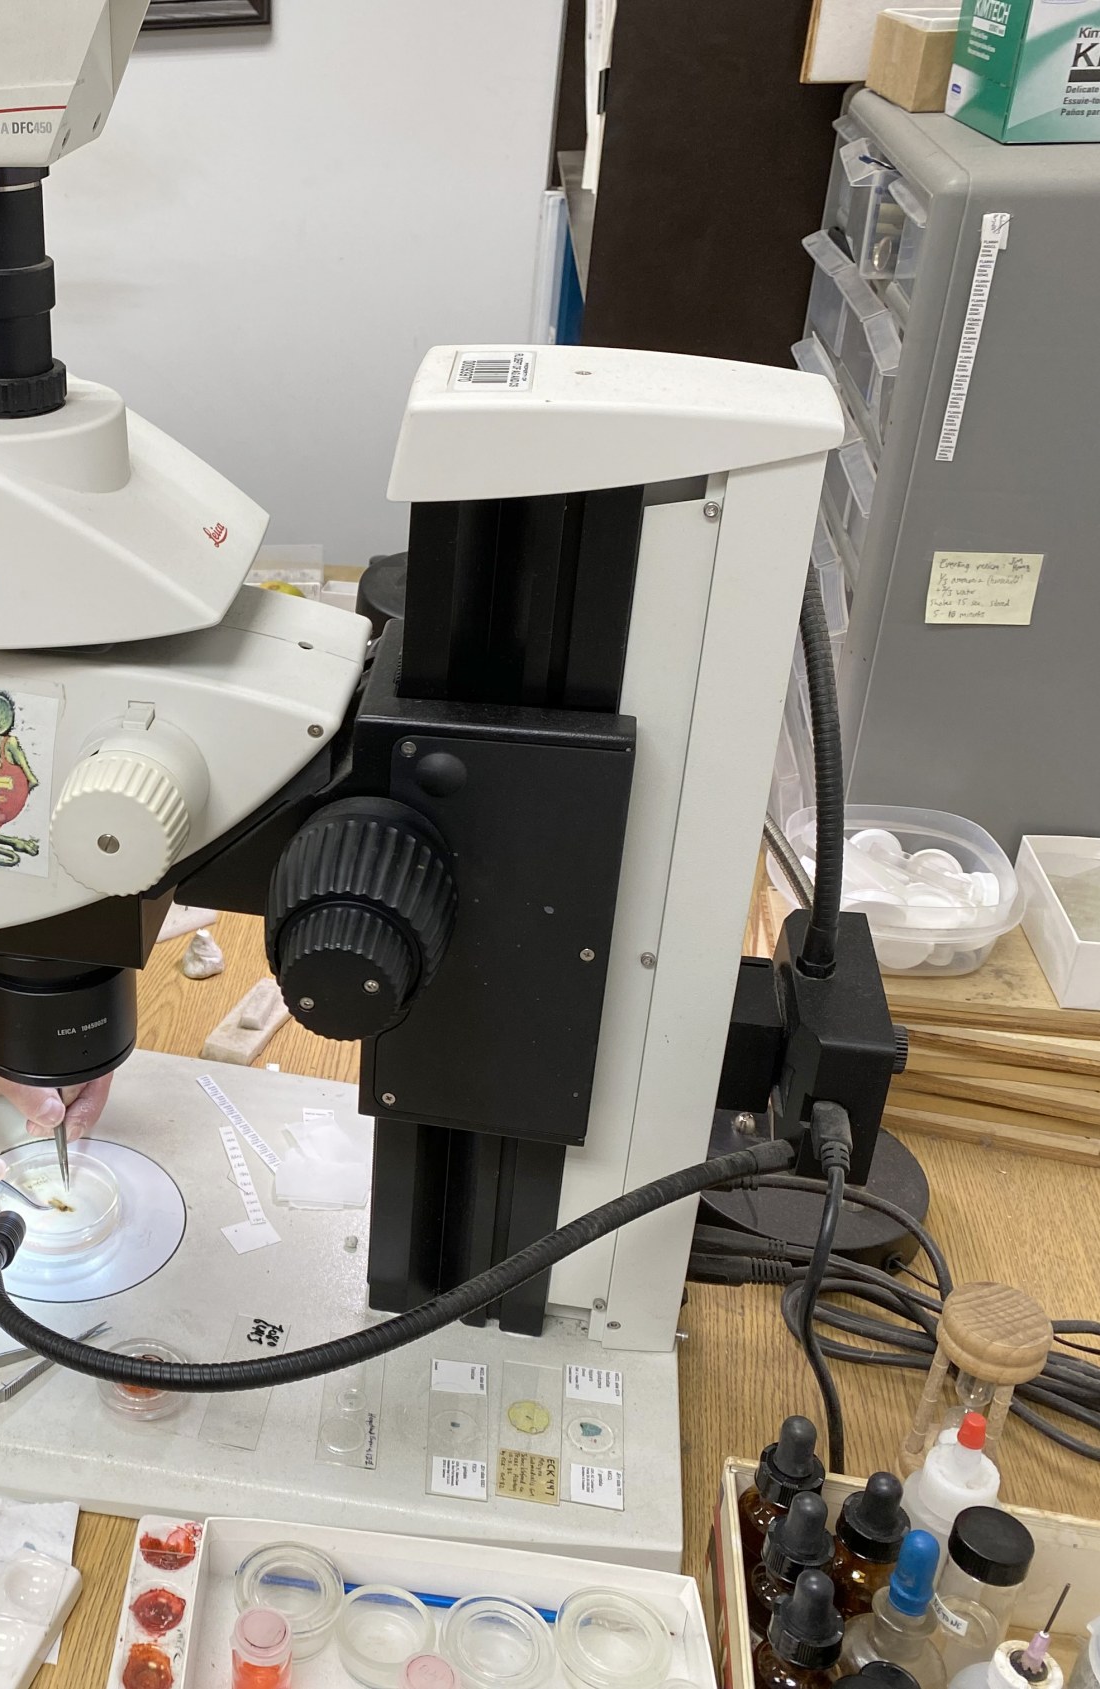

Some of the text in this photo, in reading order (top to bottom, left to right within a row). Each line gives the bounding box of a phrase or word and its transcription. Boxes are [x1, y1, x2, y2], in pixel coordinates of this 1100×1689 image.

[1071, 43, 1100, 67] K
[1065, 85, 1099, 94] Delicate
[12, 121, 53, 134] DFC450
[57, 1027, 77, 1036] LEICA
[545, 1458, 555, 1496] ECK 447
